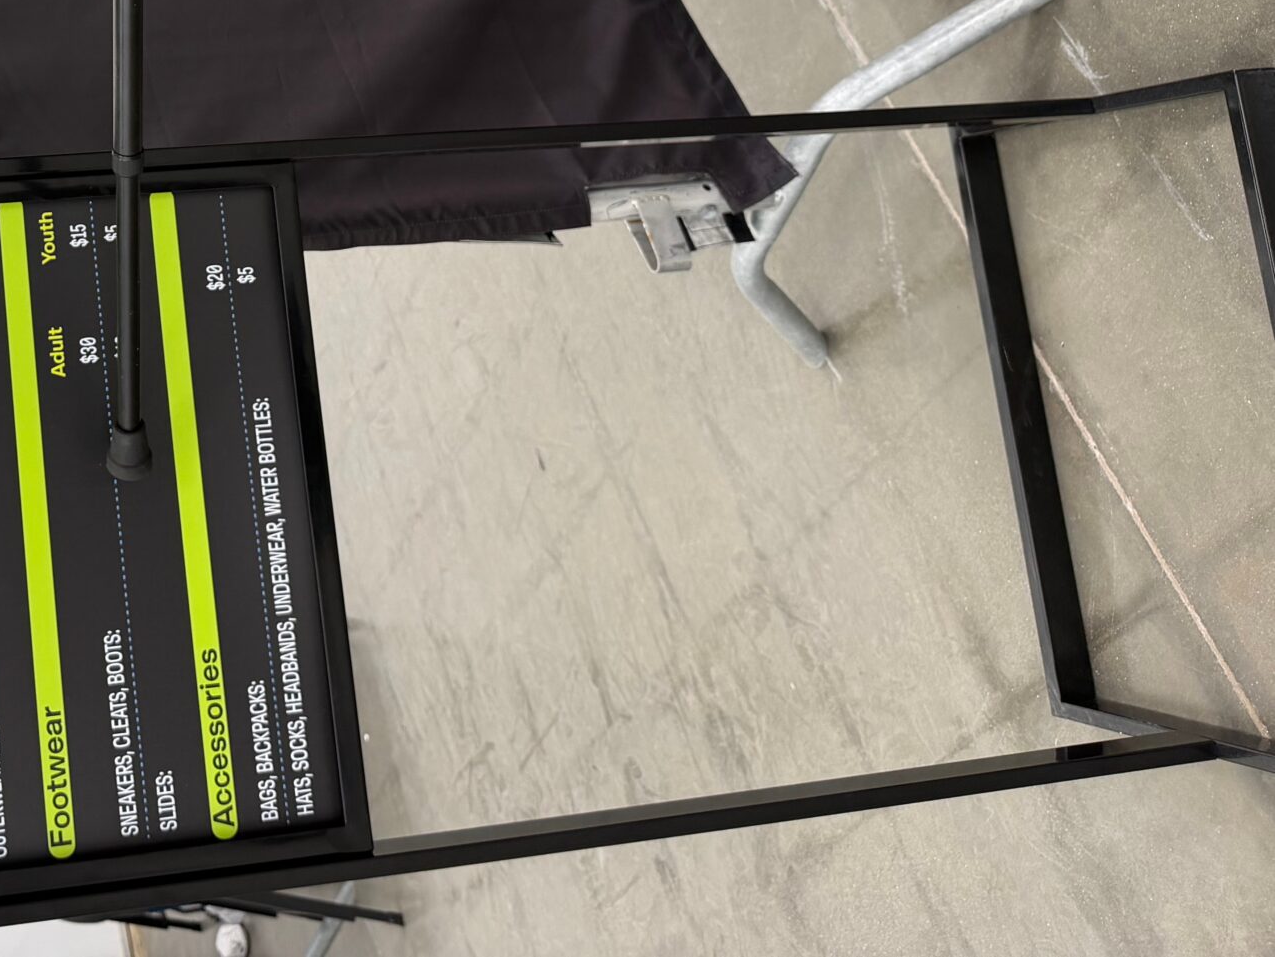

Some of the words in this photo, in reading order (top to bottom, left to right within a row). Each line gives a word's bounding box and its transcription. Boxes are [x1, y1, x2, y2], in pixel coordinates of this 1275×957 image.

[39, 212, 57, 264] Youth
[69, 224, 89, 247] $15
[103, 224, 117, 242] $5
[206, 264, 225, 290] $20
[237, 267, 256, 284] $5
[48, 326, 66, 378] Adult
[79, 336, 99, 364] $30
[253, 398, 276, 464] BOTTLES:
[259, 467, 282, 516] WATER
[266, 518, 293, 616] UNDERWEAR,
[103, 630, 125, 685] BOOTS:
[277, 618, 303, 714] HEADBANDS,
[109, 688, 131, 748] CLEATS,
[199, 648, 235, 827] Accessories
[247, 680, 275, 773] BACKPACKS:
[288, 716, 310, 770] SOCKS,
[43, 706, 73, 848] Footwear
[114, 751, 139, 836] SNEAKERS,
[155, 770, 177, 831] SLIDES:
[257, 775, 279, 822] BAGS,
[294, 773, 315, 816] HATS,
